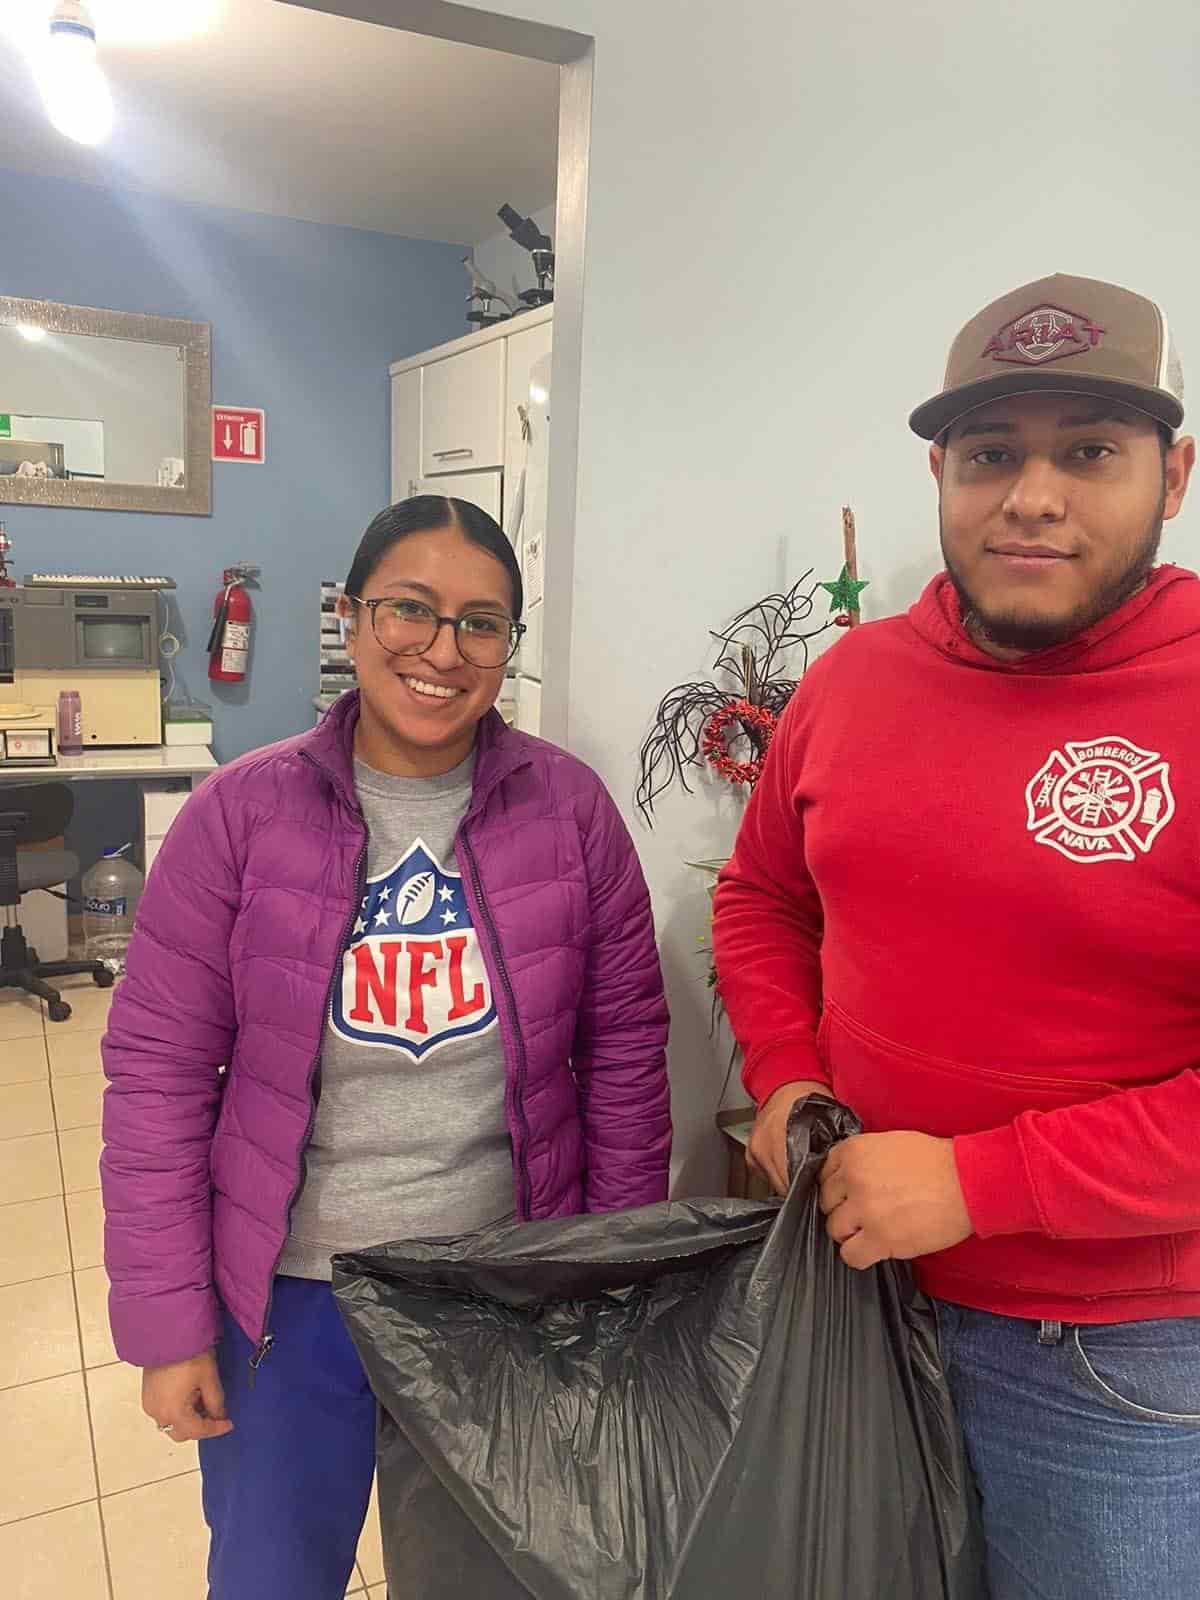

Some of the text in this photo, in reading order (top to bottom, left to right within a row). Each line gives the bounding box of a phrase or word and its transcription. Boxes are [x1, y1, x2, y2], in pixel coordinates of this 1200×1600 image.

[1078, 746, 1142, 766] BOMBEROS
[1057, 828, 1113, 851] NAVA
[349, 936, 486, 1035] NFL
